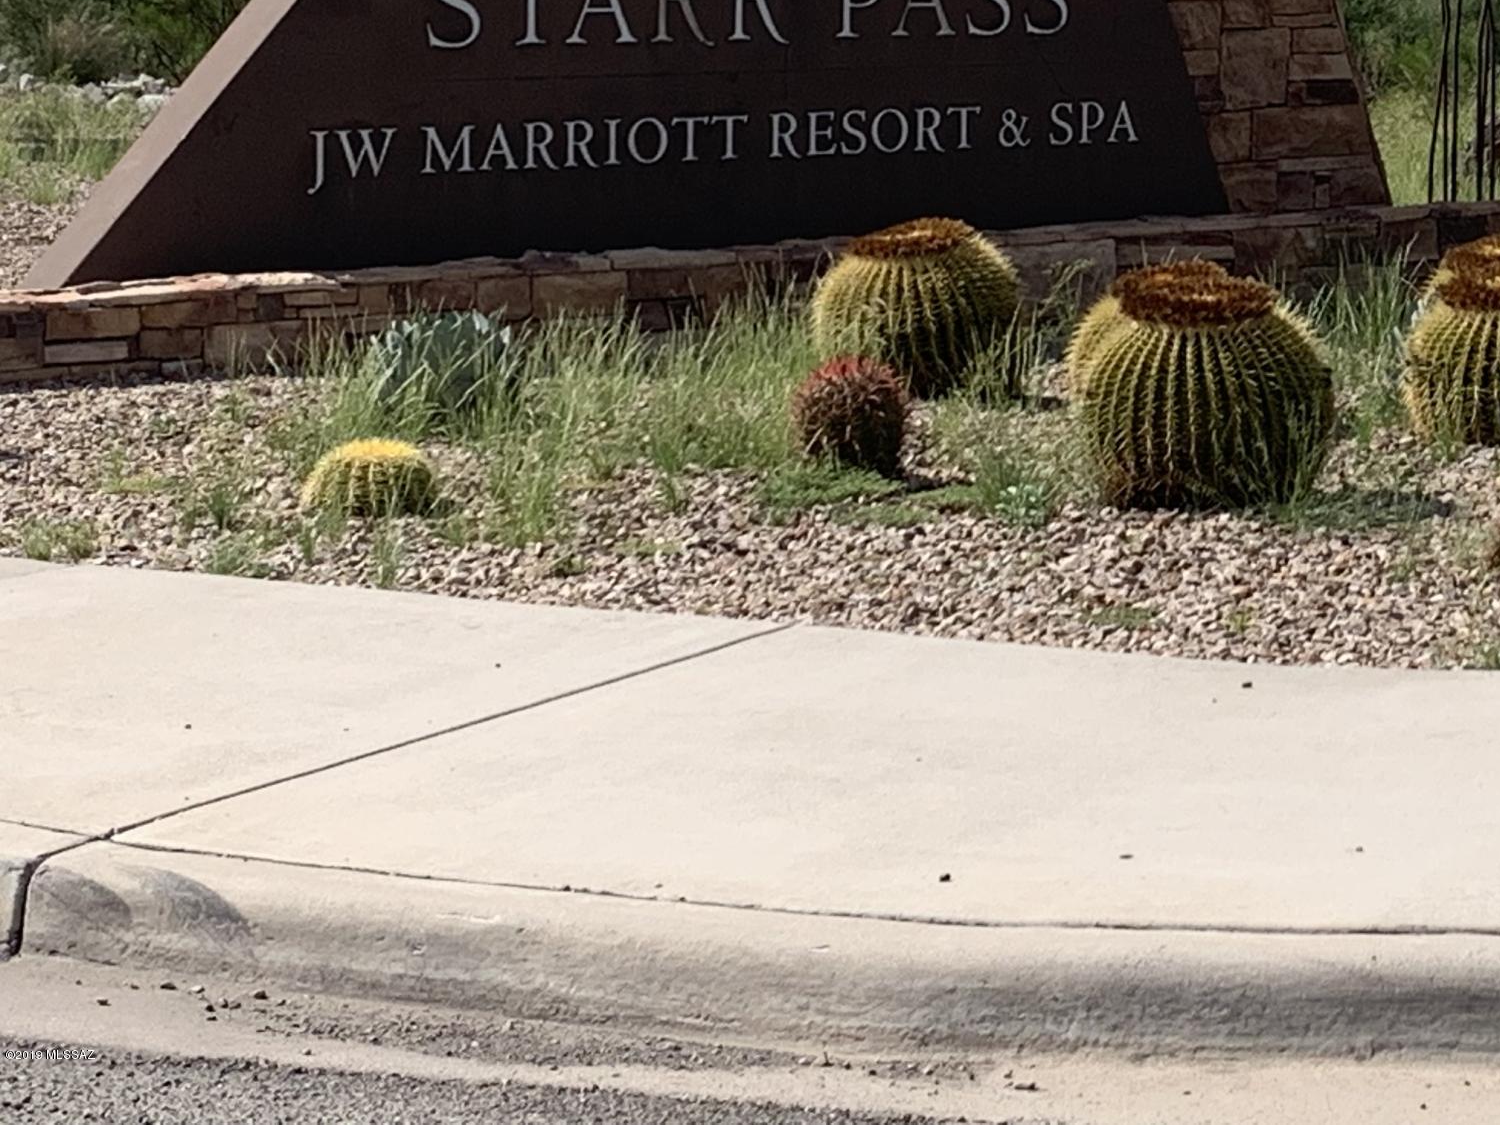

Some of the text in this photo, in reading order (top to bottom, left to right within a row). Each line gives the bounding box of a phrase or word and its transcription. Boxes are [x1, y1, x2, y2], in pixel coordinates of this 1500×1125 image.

[308, 100, 1140, 195] JW MARRIOTT RESORT & SPA
